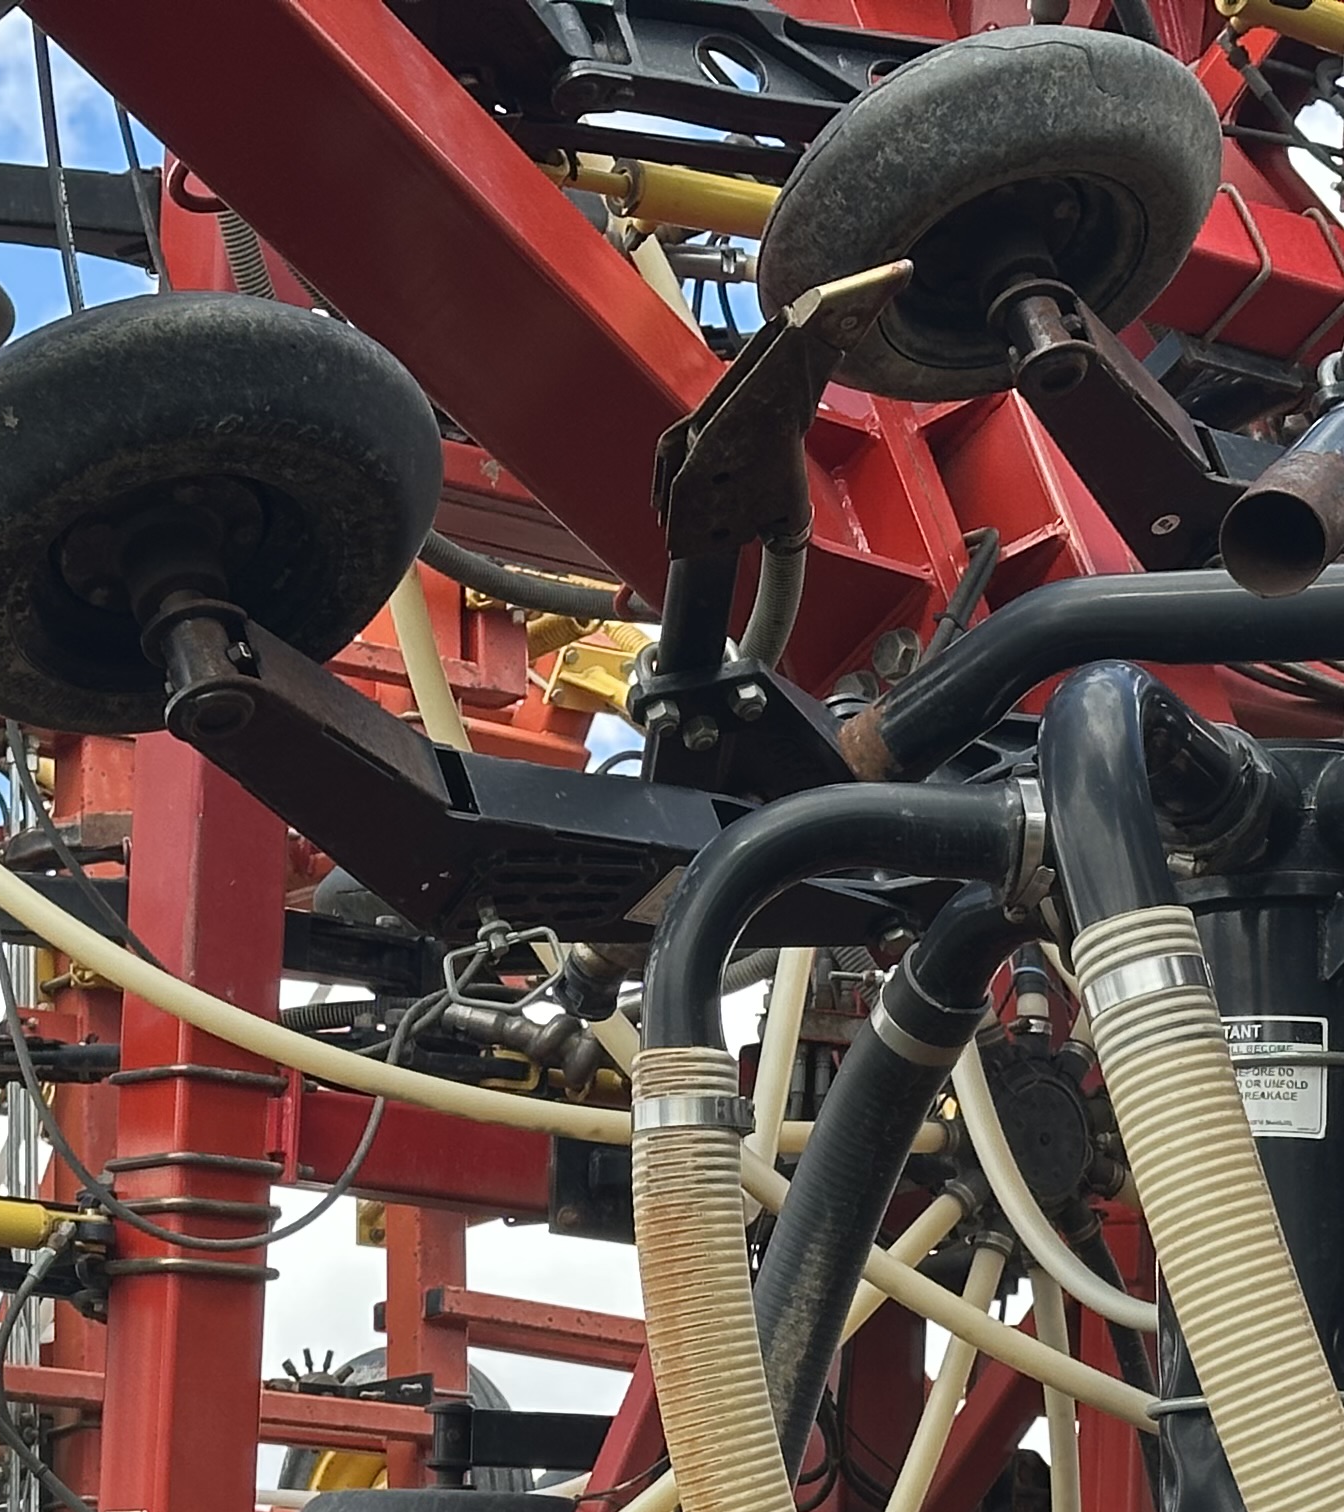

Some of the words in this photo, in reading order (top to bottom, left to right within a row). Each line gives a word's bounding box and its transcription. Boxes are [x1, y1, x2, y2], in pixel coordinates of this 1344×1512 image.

[1222, 1024, 1262, 1040] TANT
[1278, 1067, 1295, 1077] DO
[1245, 1079, 1262, 1089] OR
[1264, 1080, 1309, 1090] UNFOLD
[1242, 1091, 1298, 1101] REAKAGE
